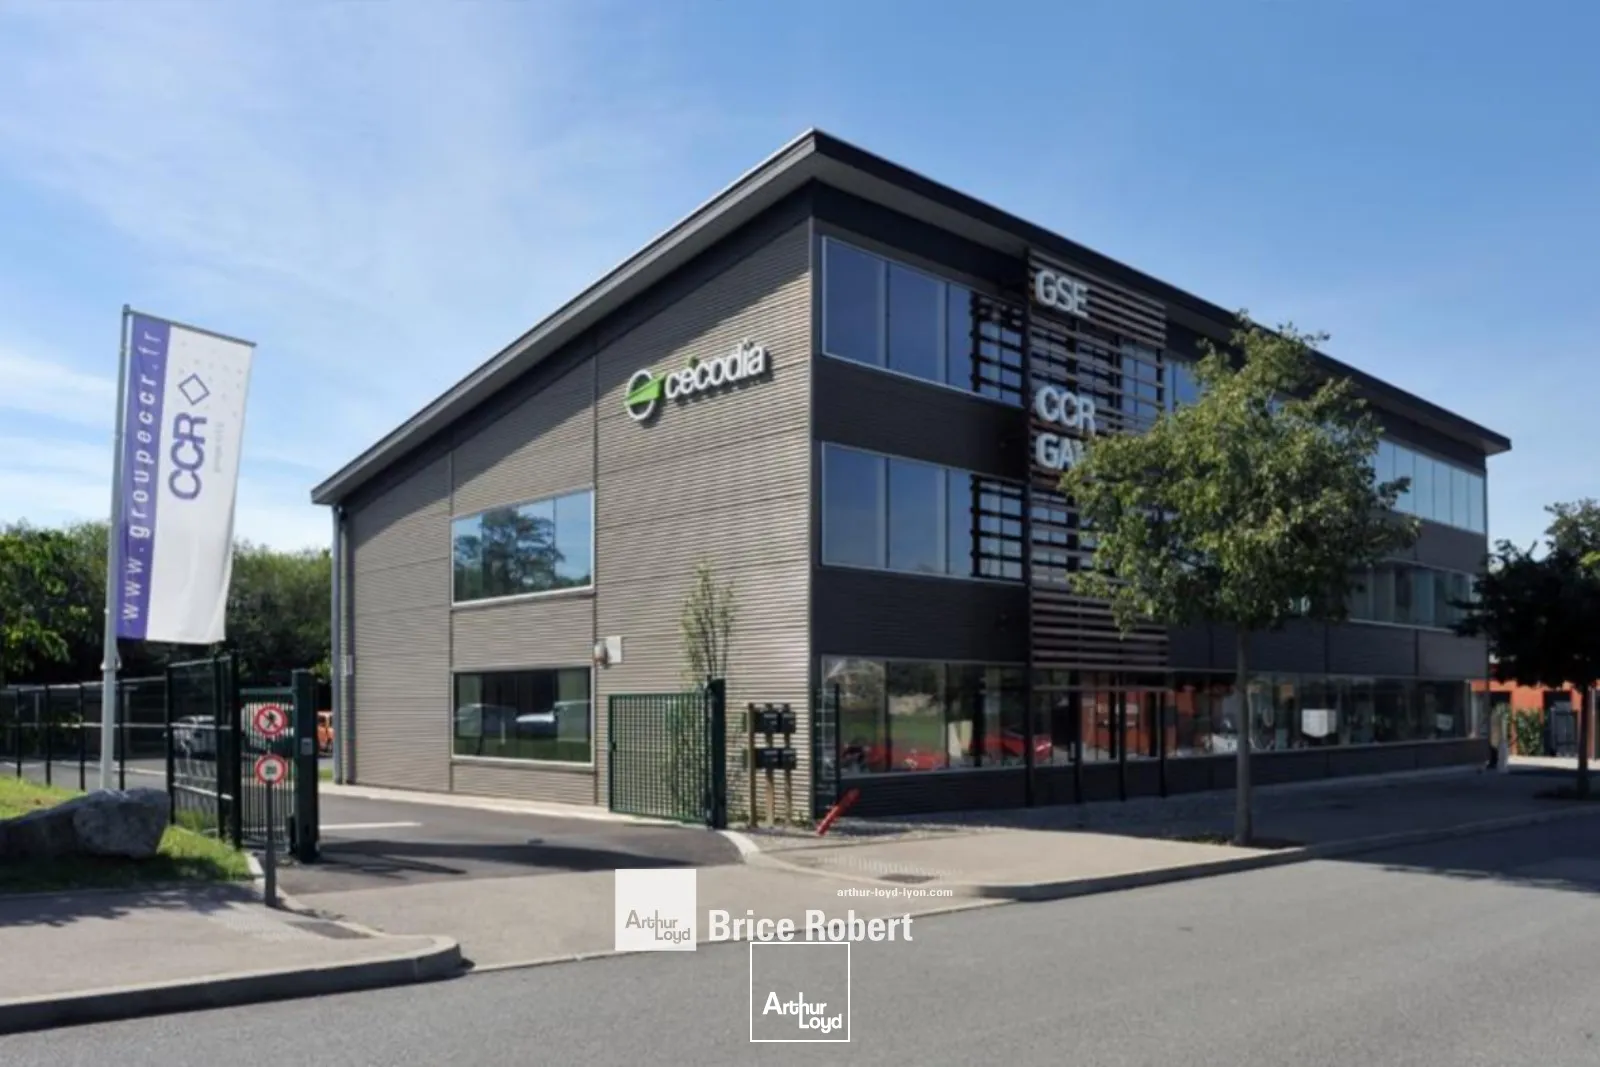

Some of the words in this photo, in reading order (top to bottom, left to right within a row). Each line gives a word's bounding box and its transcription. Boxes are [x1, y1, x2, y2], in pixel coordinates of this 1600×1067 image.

[1035, 269, 1089, 318] GSE
[1035, 384, 1096, 436] CCR
[122, 330, 162, 621] www.groupeccr.fr
[168, 411, 208, 501] CCR
